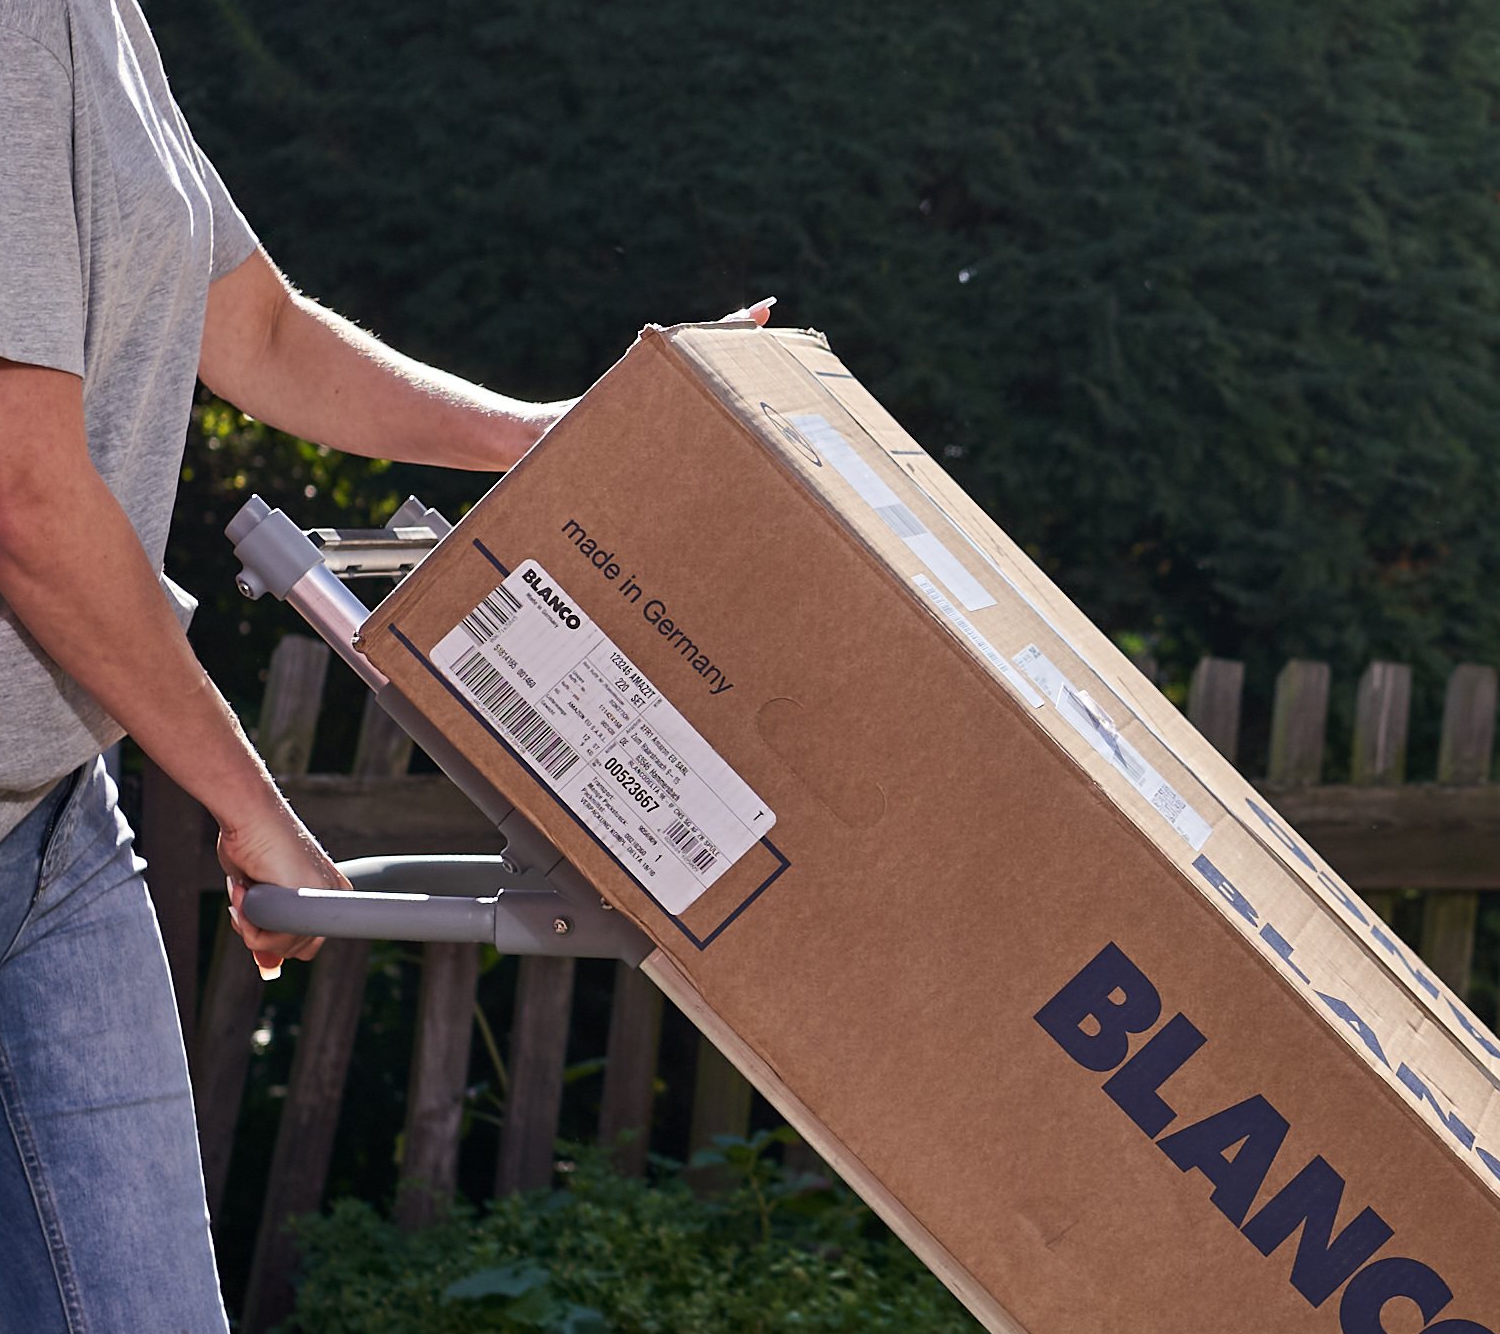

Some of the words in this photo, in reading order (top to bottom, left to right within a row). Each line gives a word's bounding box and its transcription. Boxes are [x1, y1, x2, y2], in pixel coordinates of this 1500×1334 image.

[521, 568, 580, 629] BLANCO
[561, 519, 621, 580] made
[618, 575, 643, 604] in
[643, 599, 734, 695] Germany
[614, 677, 629, 692] 220
[630, 693, 646, 708] SET
[630, 732, 642, 745] Zum
[651, 736, 669, 756] Amazon
[667, 753, 677, 763] EU
[674, 761, 688, 776] SARL
[604, 757, 659, 812] 00523667
[580, 796, 611, 829] VERPACKUNG
[626, 846, 642, 863] DELTA
[753, 810, 764, 820] T
[654, 854, 662, 862] 1
